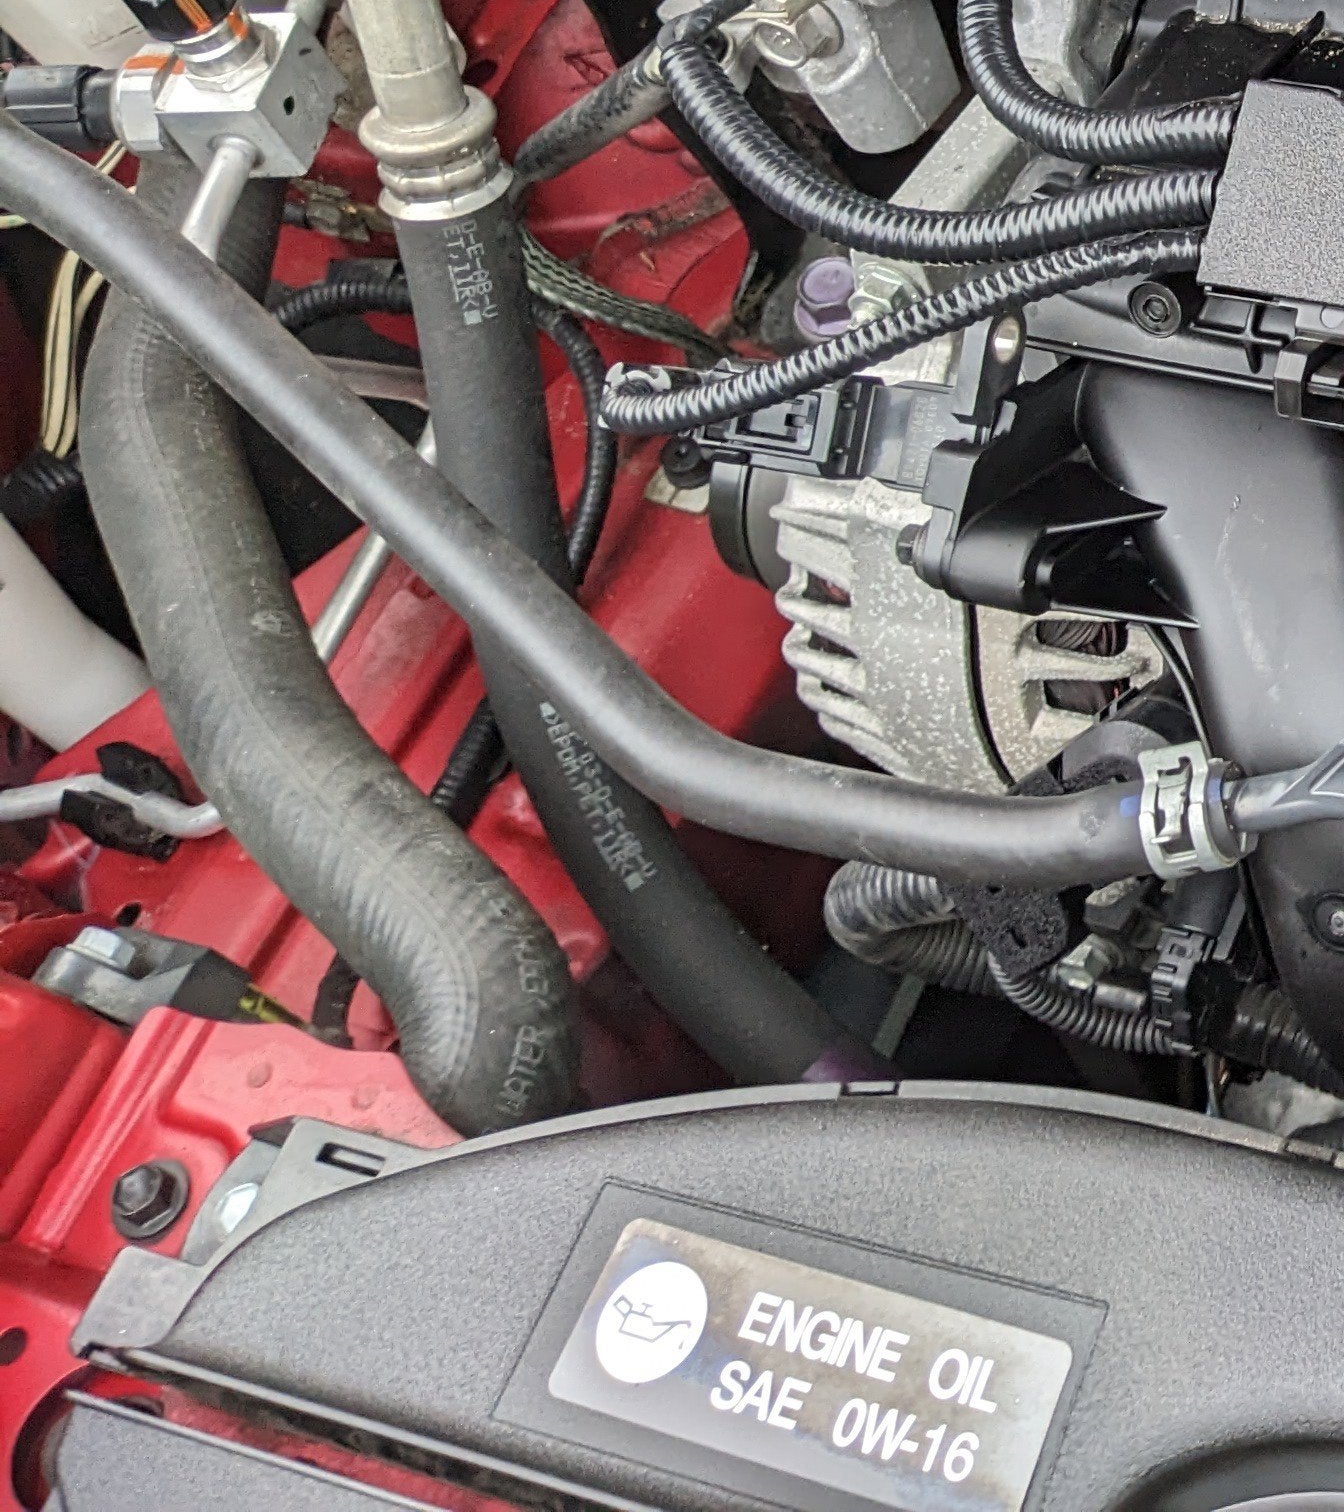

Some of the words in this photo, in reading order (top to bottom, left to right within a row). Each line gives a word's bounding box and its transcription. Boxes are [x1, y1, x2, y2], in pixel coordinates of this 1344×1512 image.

[736, 1289, 911, 1384] ENGINE
[927, 1346, 1001, 1416] OIL
[708, 1359, 813, 1431] SAE
[830, 1397, 981, 1484] 0W-16
